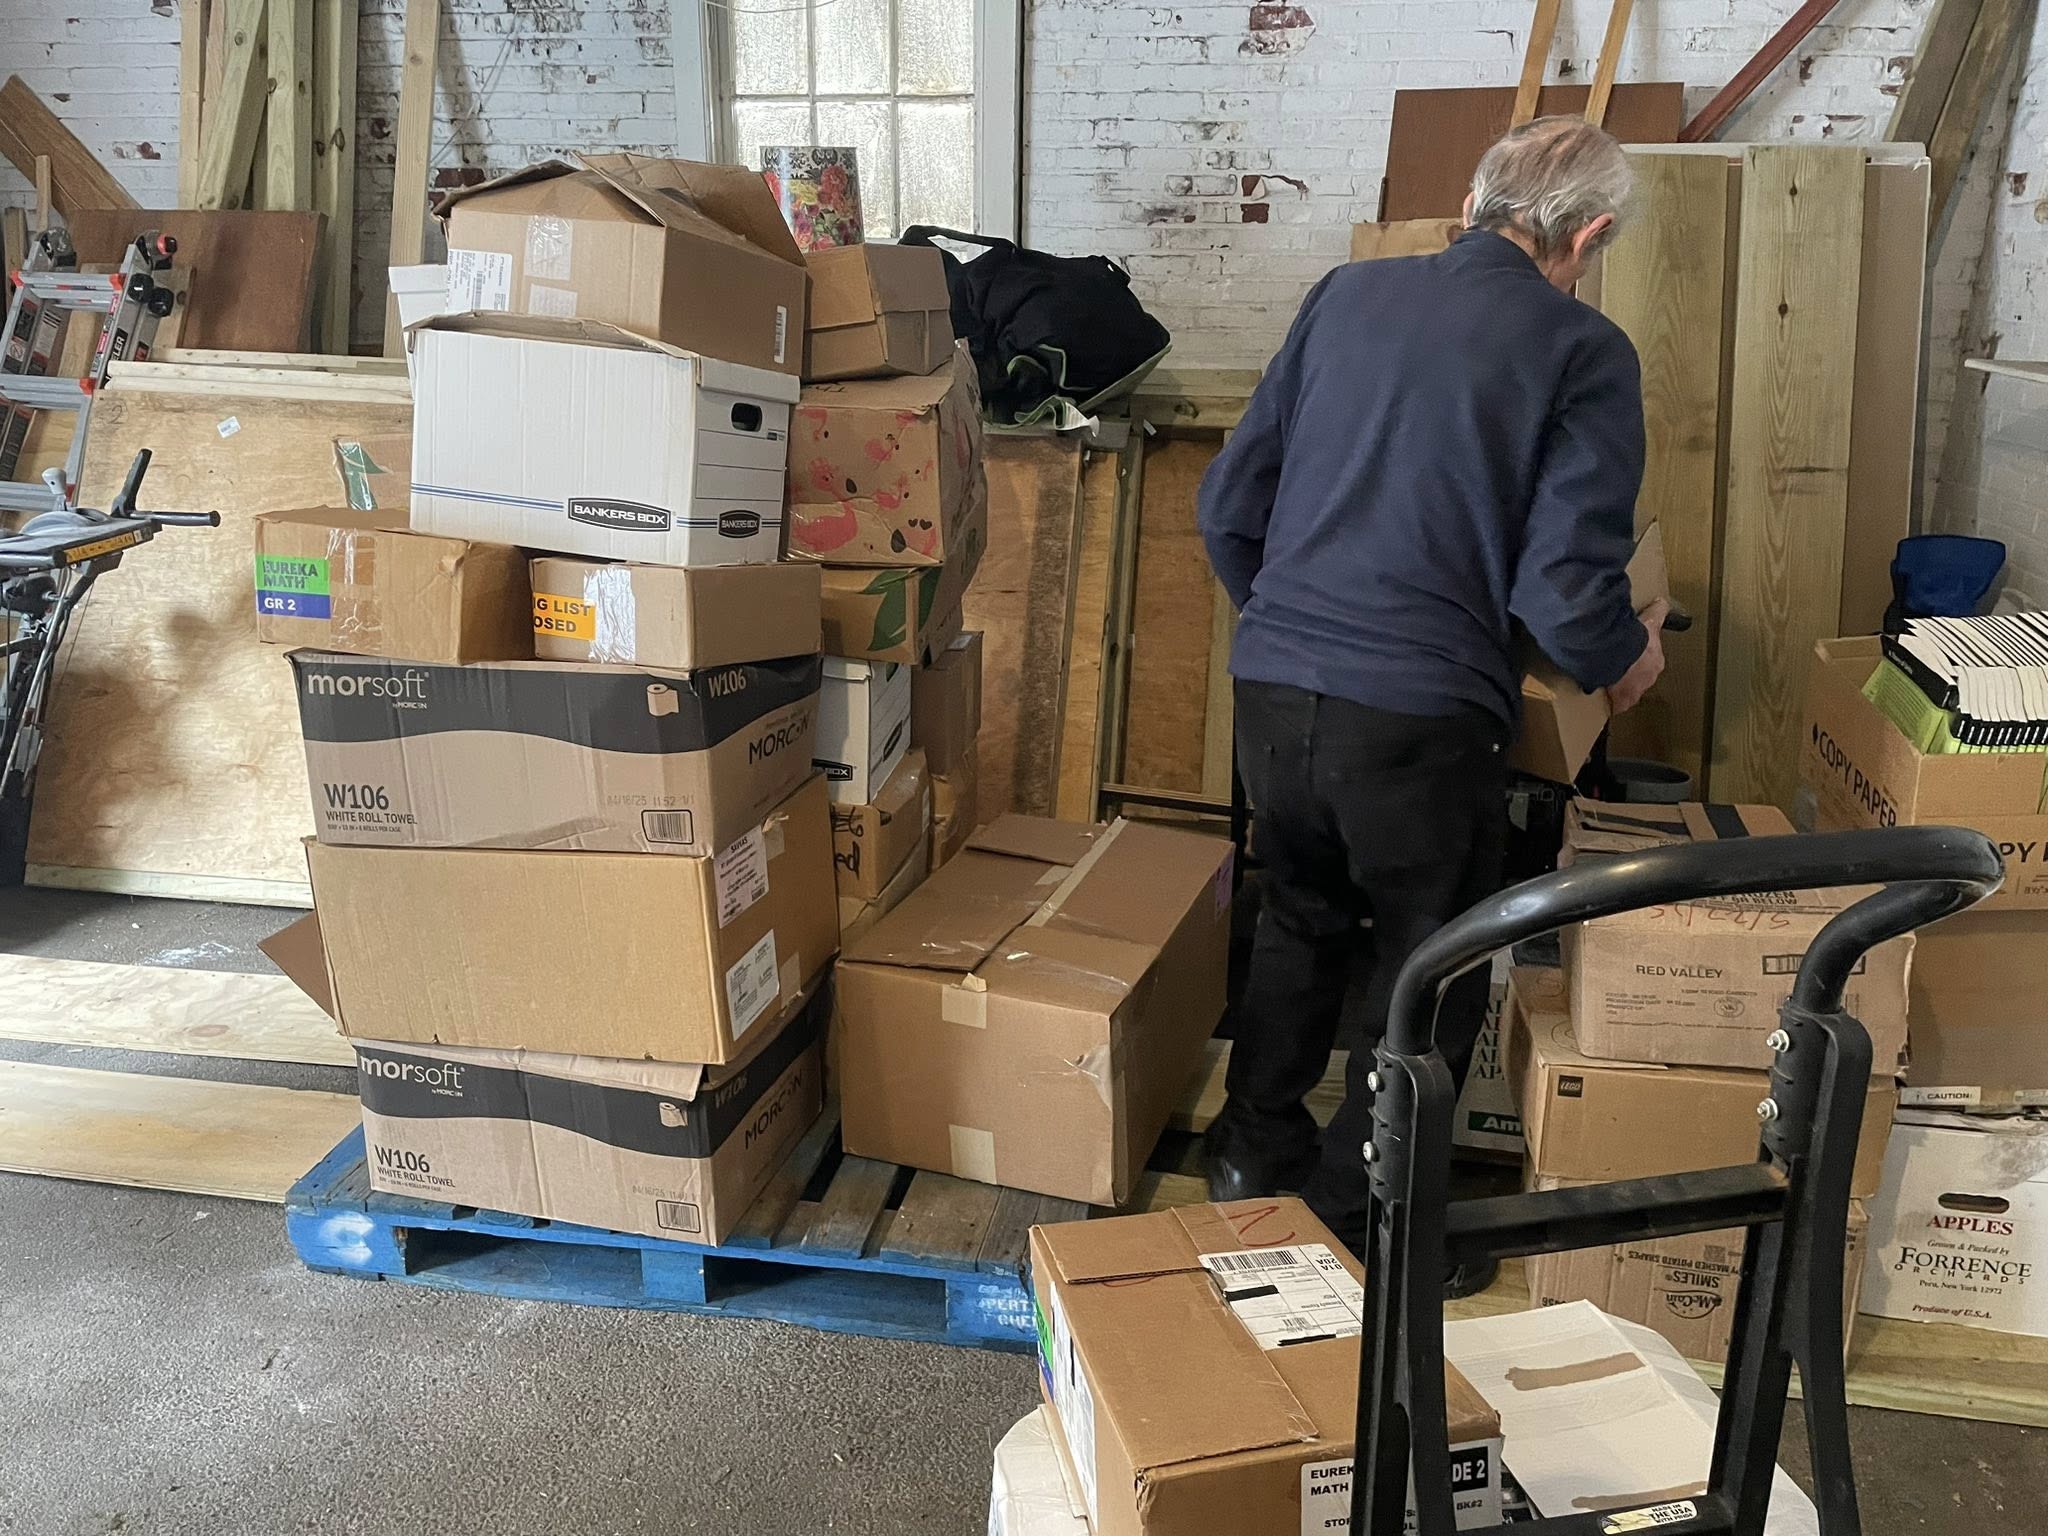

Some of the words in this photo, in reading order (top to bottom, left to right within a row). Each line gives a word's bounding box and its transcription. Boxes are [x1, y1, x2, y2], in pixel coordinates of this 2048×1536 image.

[574, 504, 636, 521] BANKERS
[638, 512, 666, 525] BOX
[262, 560, 318, 577] EUREKA
[264, 597, 285, 610] GR
[287, 599, 297, 611] 2
[554, 600, 591, 616] LIST
[308, 669, 427, 698] morsoft
[708, 668, 747, 698] W106
[1819, 732, 1852, 786] COPY
[1854, 769, 1897, 828] PAPER
[323, 783, 389, 810] W106
[326, 810, 356, 822] WHITE
[358, 812, 383, 823] ROLL
[384, 813, 418, 825] TOWEL
[2000, 842, 2037, 863] PY
[1636, 965, 1666, 976] RED
[1669, 966, 1724, 978] VALLEY
[360, 1055, 463, 1089] morsoft
[1560, 1081, 1581, 1090] LEGO
[374, 1144, 430, 1173] W106
[377, 1166, 402, 1180] WHITE
[403, 1172, 425, 1183] ROLL
[427, 1175, 456, 1188] TOWEL
[1926, 1215, 2014, 1236] APPLES
[1927, 1239, 1956, 1250] Grown
[1967, 1243, 1999, 1255] Packed
[1628, 1250, 1661, 1263] SHAPES
[1662, 1255, 1693, 1268] POTATO
[1900, 1246, 2032, 1278] FORRENCE
[1694, 1259, 1730, 1273] MASHED
[1673, 1269, 1720, 1289] SMILES
[1894, 1263, 2025, 1286] ORCHARDS
[1941, 1281, 1957, 1290] New
[1960, 1284, 1979, 1293] York
[1666, 1293, 1711, 1309] McCain
[1912, 1303, 1950, 1316] Produce
[1951, 1307, 1963, 1317] of
[1311, 1465, 1354, 1479] EUREK
[1452, 1461, 1473, 1482] DE
[1476, 1459, 1486, 1479] 2
[1310, 1483, 1349, 1496] MATH
[1649, 1511, 1670, 1521] THE
[1670, 1507, 1693, 1518] USA
